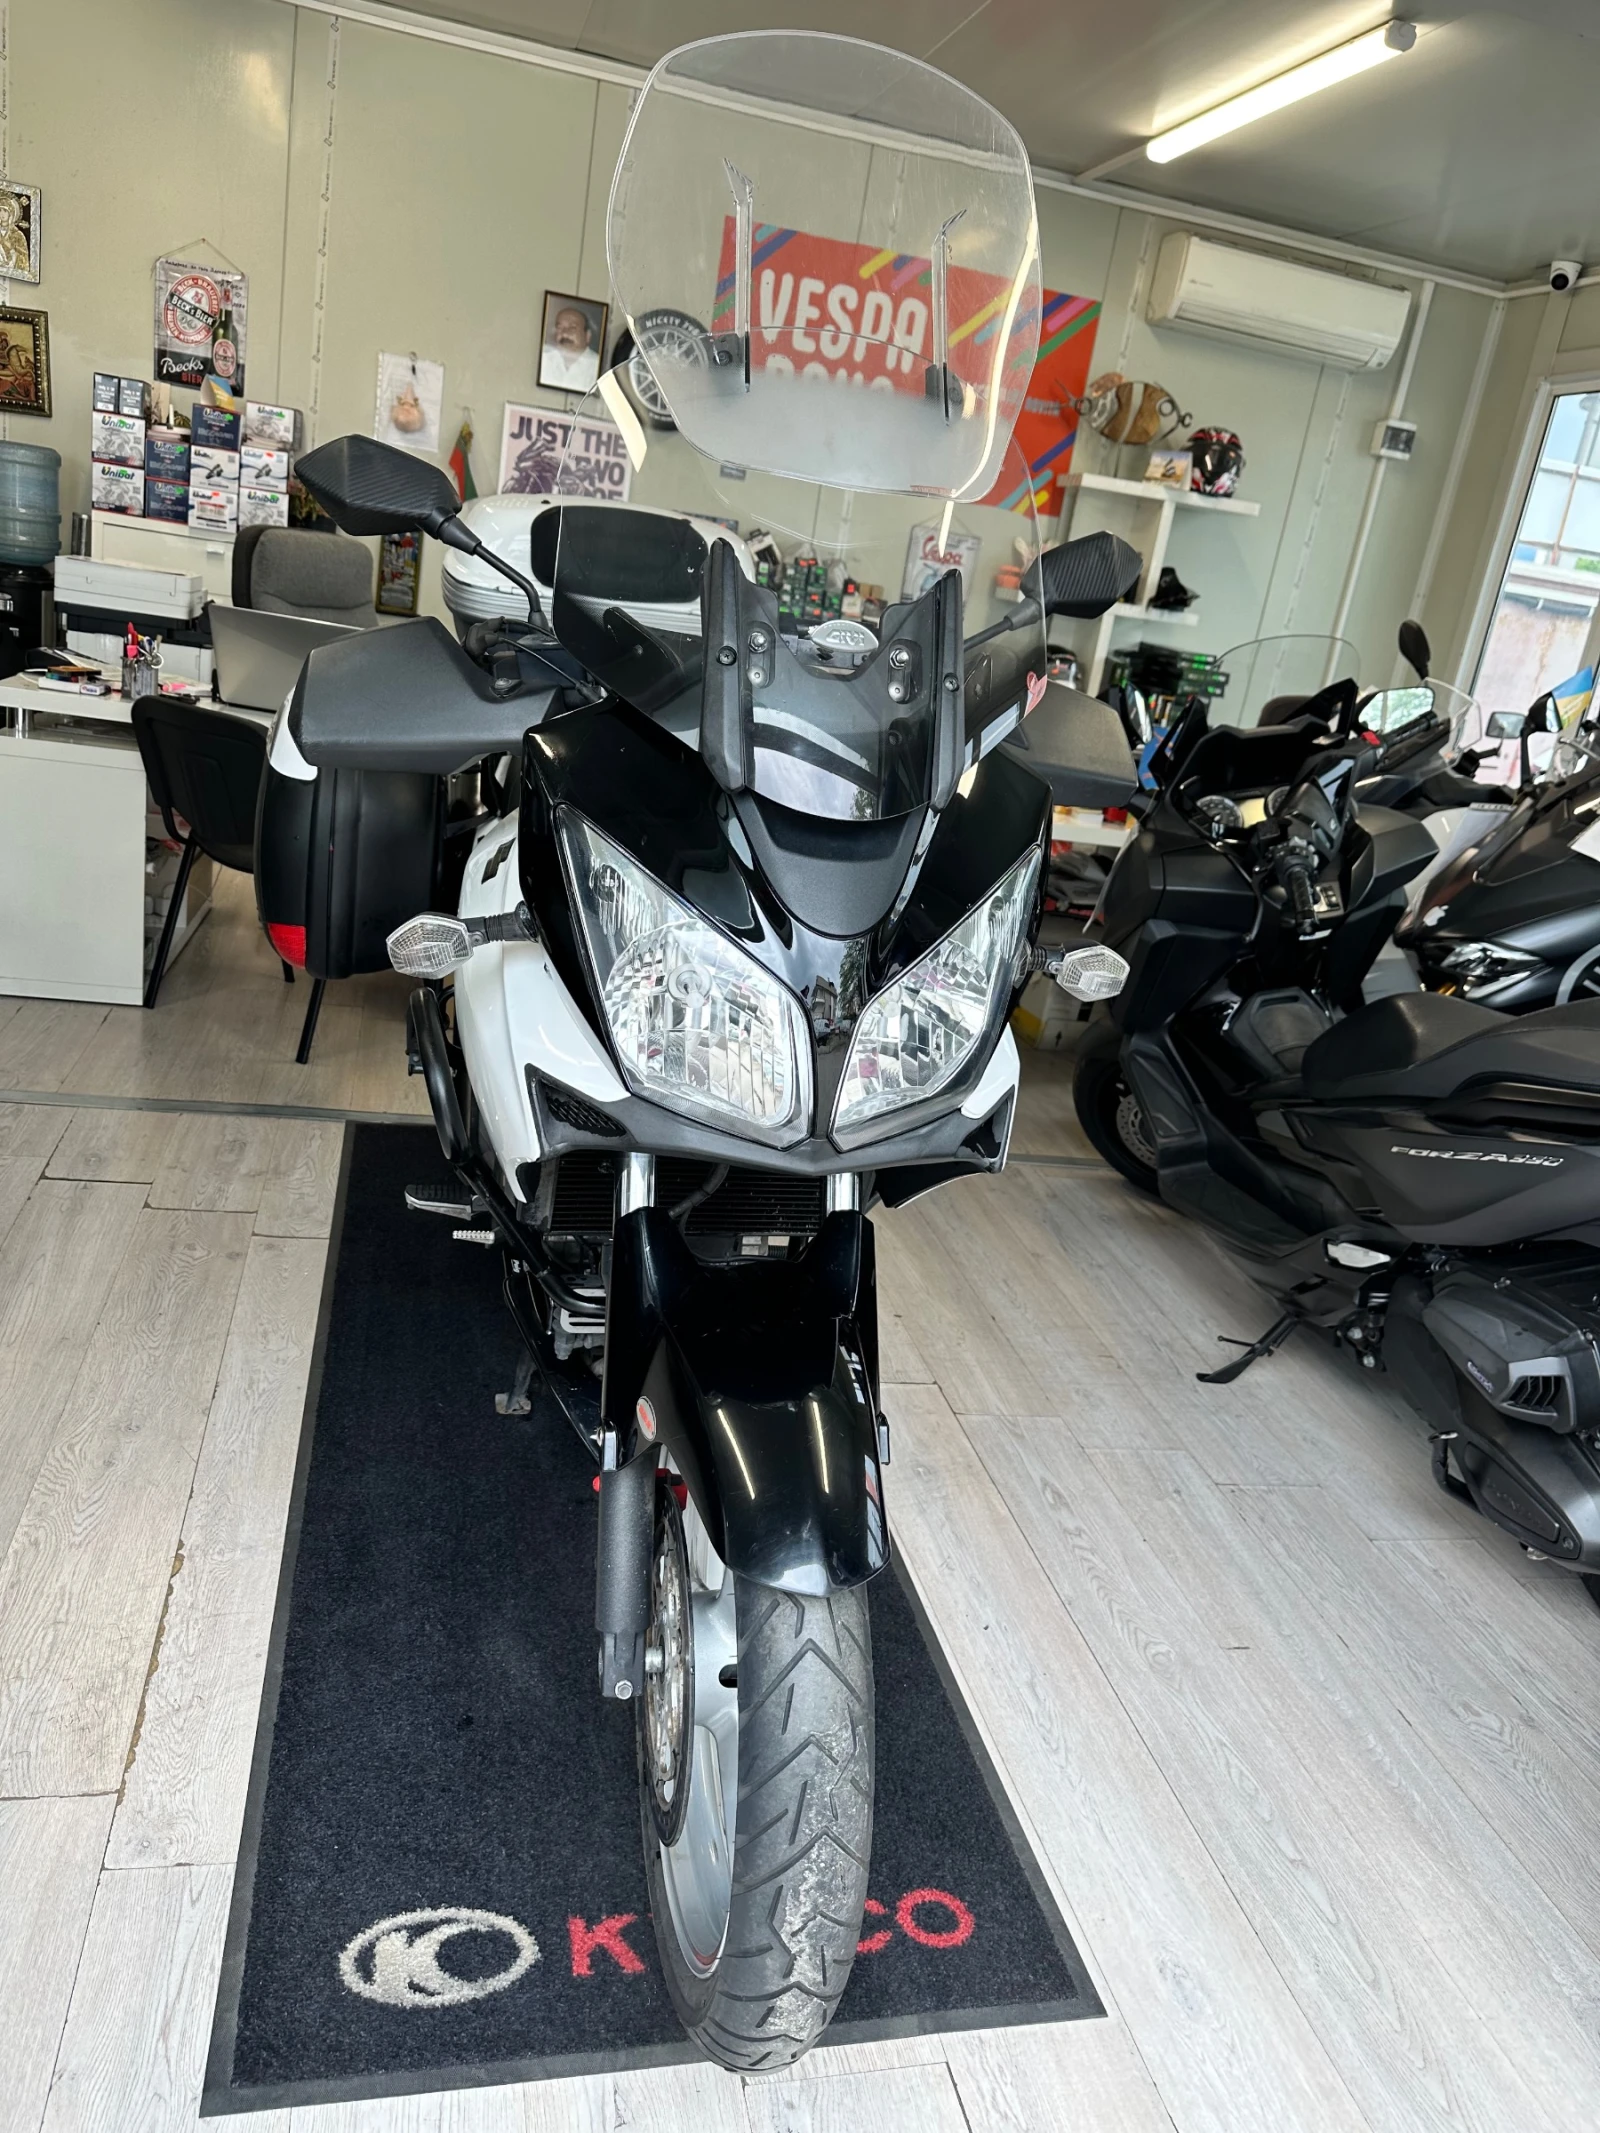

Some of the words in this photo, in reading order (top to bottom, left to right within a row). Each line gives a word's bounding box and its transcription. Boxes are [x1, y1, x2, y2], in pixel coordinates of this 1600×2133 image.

[195, 308, 213, 327] BIER
[759, 268, 928, 374] VESPA
[181, 371, 203, 385] BIER
[101, 415, 136, 431] Unibat
[509, 415, 576, 450] JUST
[580, 427, 628, 459] THE
[101, 466, 136, 481] Unibat
